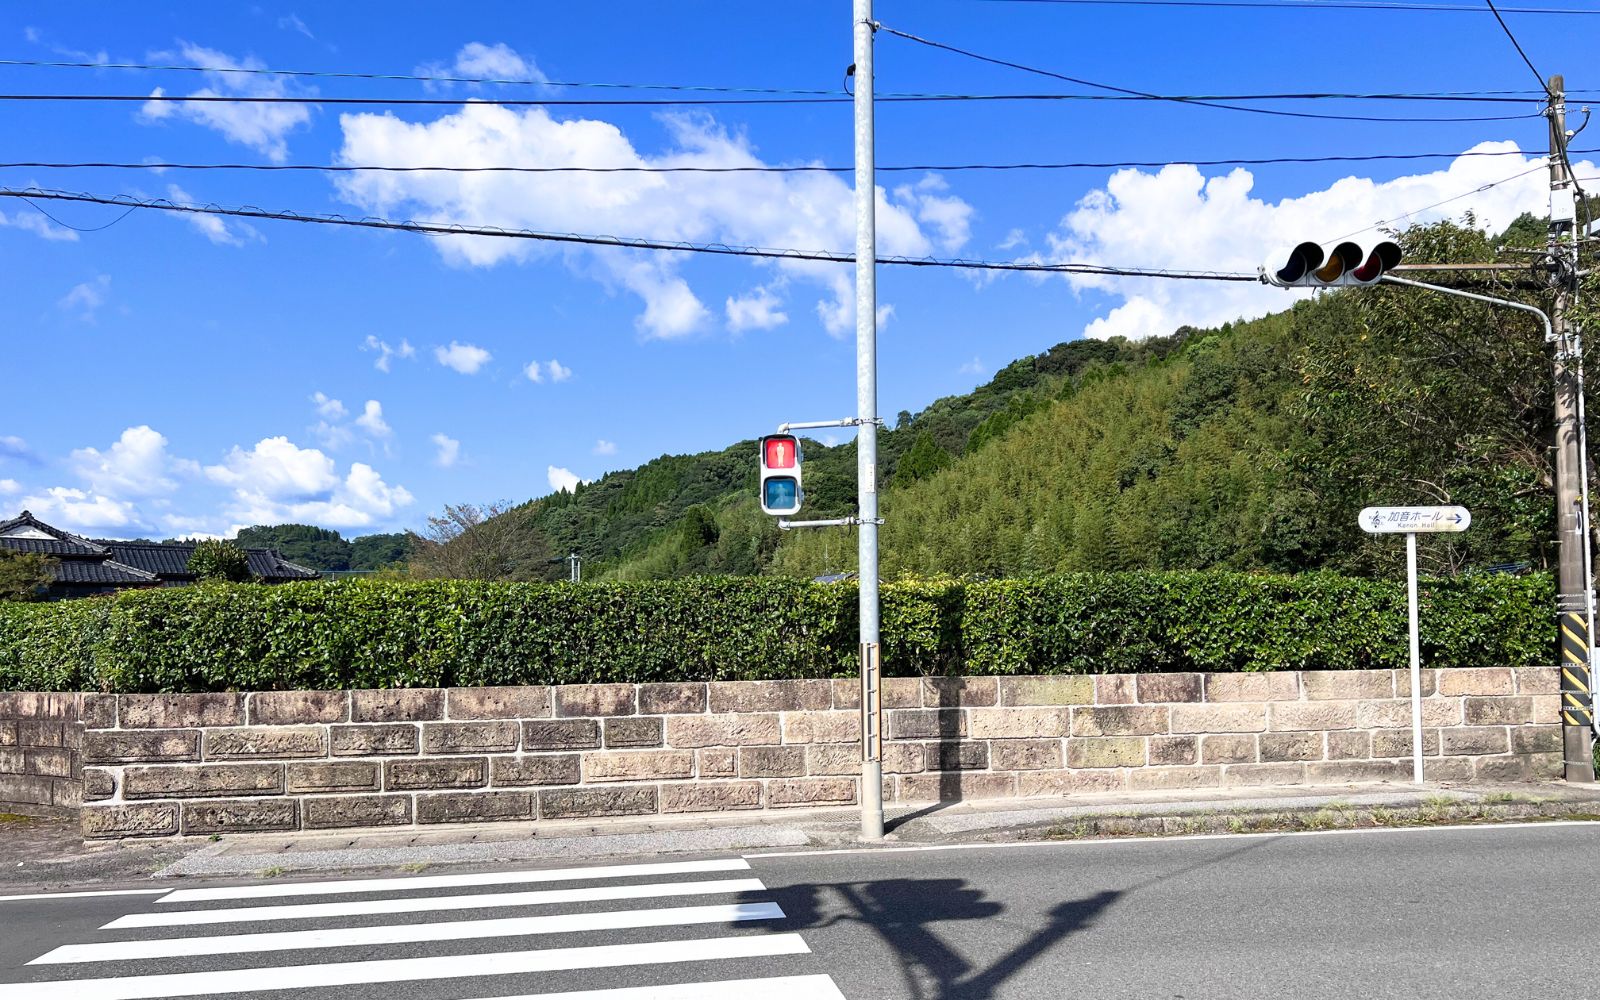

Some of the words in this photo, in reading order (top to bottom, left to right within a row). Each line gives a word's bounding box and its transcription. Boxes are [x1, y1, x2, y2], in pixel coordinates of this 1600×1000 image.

[1387, 511, 1444, 522] 加音ホール
